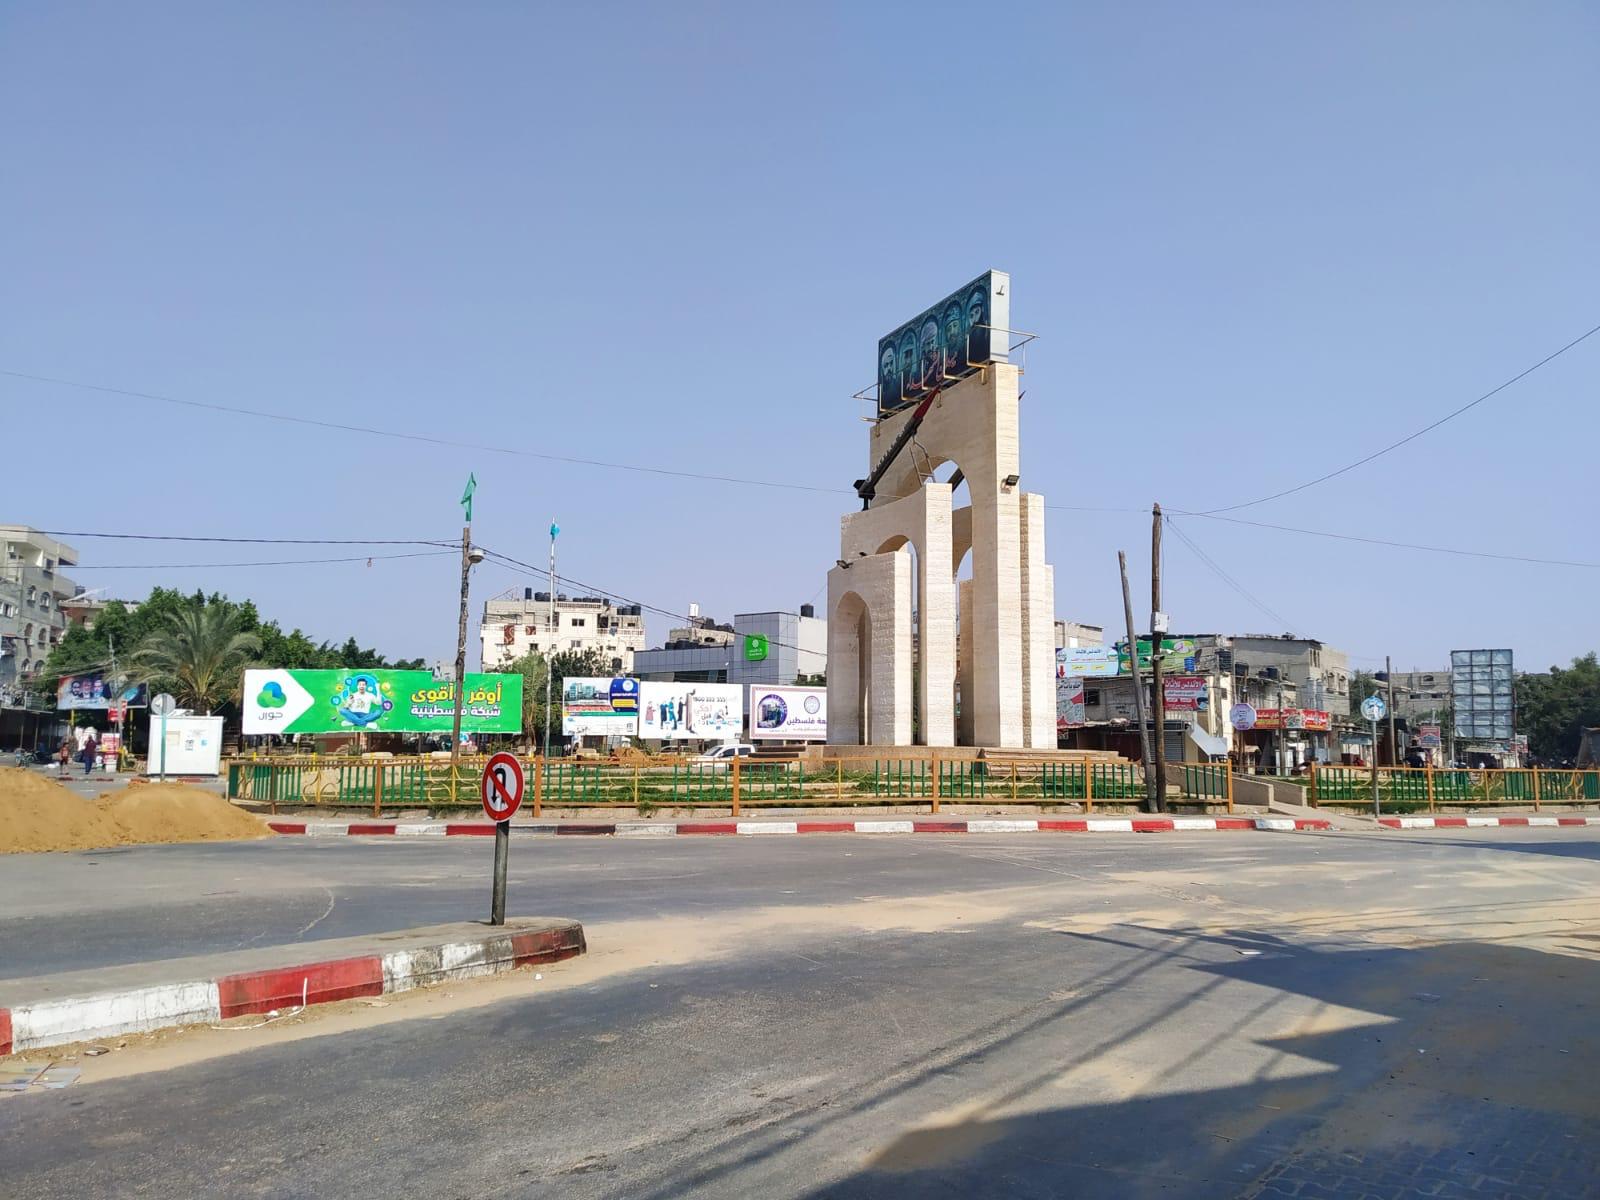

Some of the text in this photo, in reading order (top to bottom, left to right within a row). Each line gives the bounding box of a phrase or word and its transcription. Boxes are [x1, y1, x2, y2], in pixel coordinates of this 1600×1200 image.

[411, 682, 502, 704] أوفر أقوى
[258, 711, 284, 721] جوال
[411, 704, 501, 719] شبكة فسطينية
[786, 716, 816, 726] فلسطين
